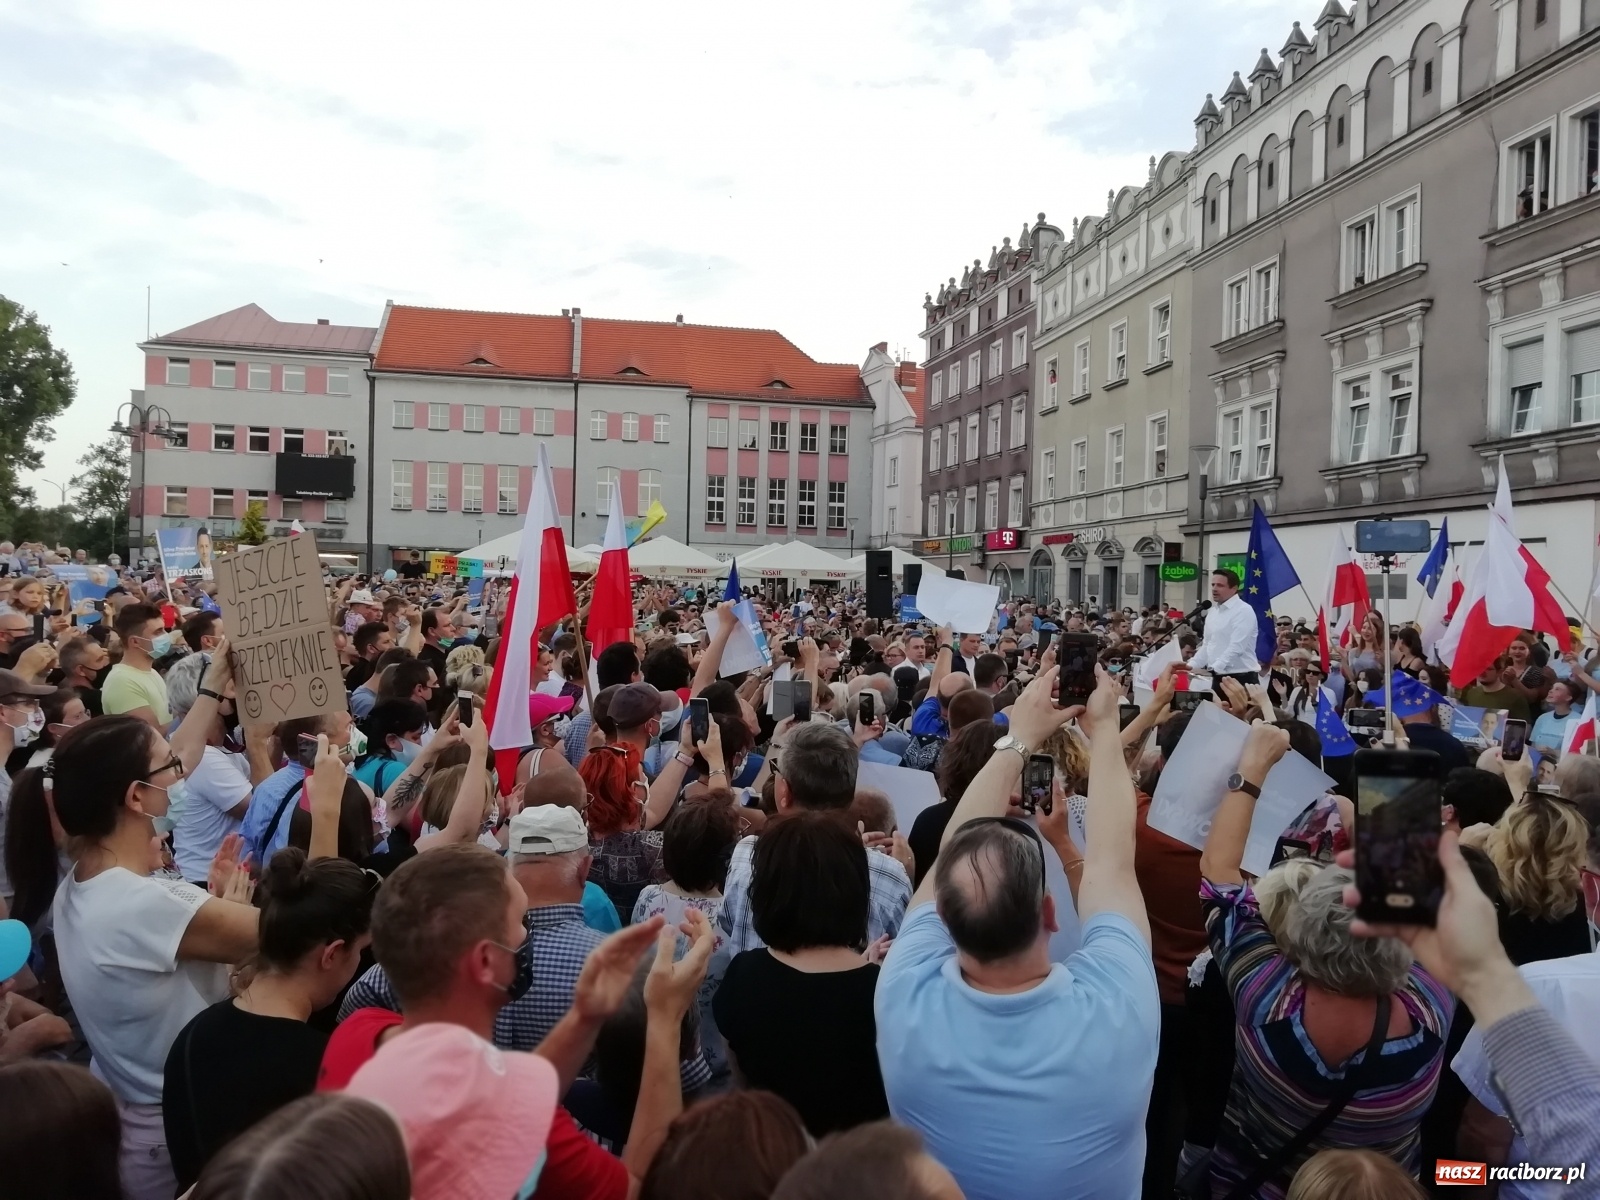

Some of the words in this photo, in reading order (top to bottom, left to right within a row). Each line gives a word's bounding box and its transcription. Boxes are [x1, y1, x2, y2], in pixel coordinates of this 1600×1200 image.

[1081, 527, 1104, 543] SHIRO
[222, 538, 306, 606] JESZCZE
[1165, 565, 1195, 575] żabka
[236, 584, 309, 638] BĘDZIE
[230, 630, 333, 687] PRZEPIĘKNIE
